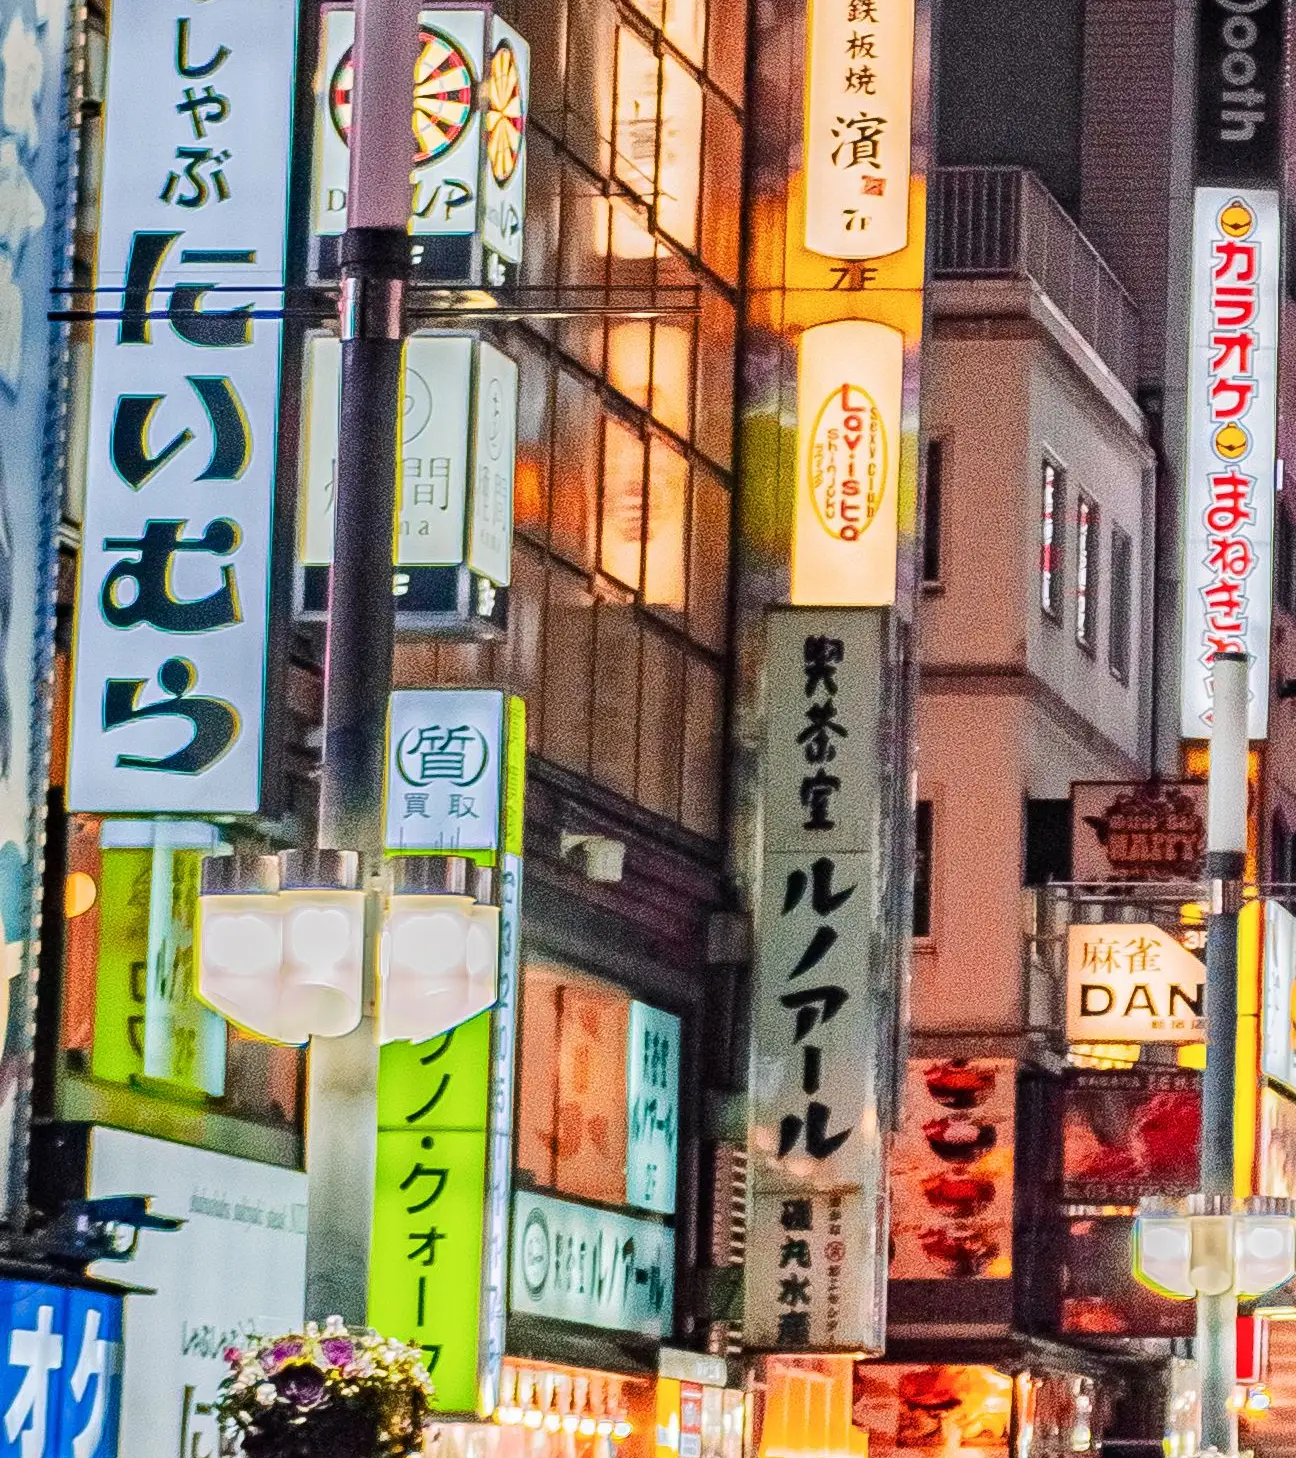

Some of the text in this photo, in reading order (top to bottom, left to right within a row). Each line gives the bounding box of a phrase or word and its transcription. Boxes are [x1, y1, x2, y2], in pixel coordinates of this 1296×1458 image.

[159, 0, 233, 210] しゃぶ
[844, 0, 880, 96] 鉄板焼
[1219, 0, 1266, 142] ooth
[831, 111, 887, 170] 濱
[842, 208, 872, 231] 7F
[1210, 241, 1260, 421] カラオケ
[99, 230, 258, 777] にいむら
[402, 792, 480, 820] 買取
[777, 856, 857, 1164] ルノアール
[1079, 935, 1164, 976] 麻雀
